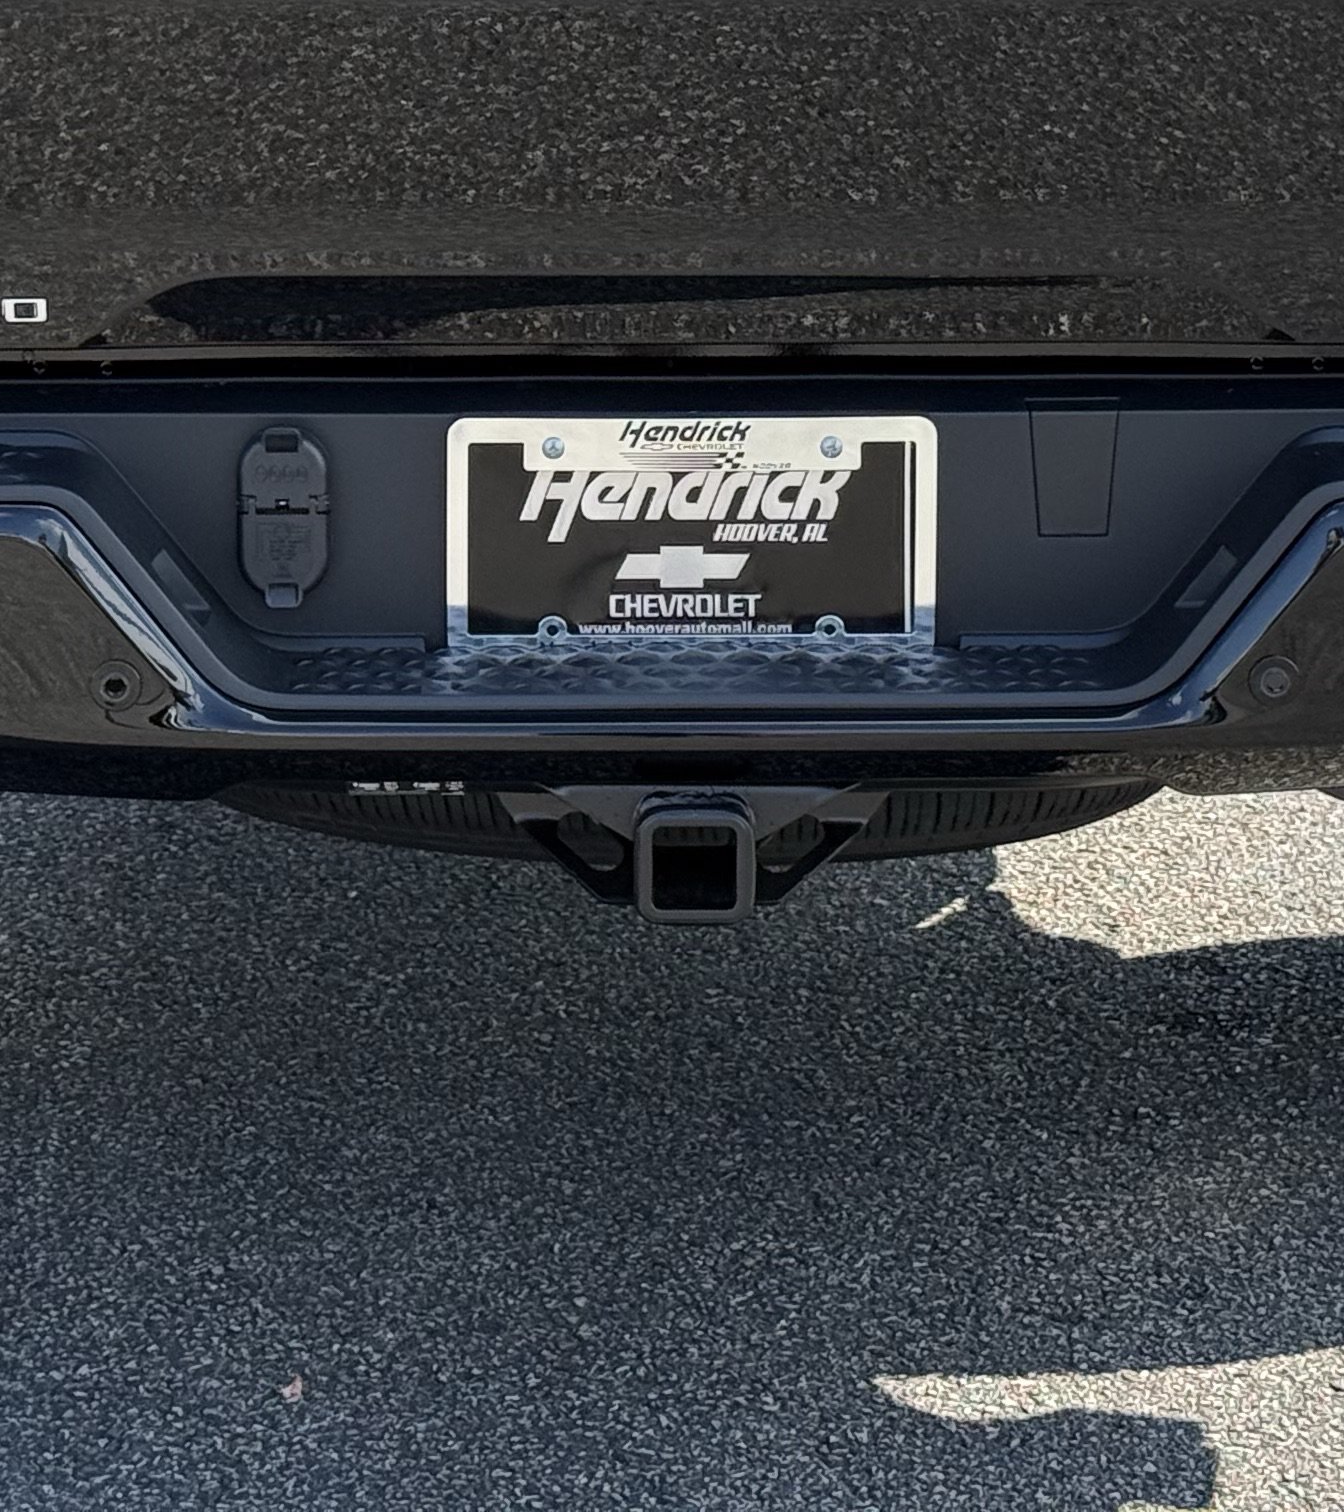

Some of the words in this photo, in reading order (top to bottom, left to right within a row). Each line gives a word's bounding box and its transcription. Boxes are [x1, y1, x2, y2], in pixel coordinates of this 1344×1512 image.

[619, 420, 752, 449] Hendrick
[676, 442, 744, 451] CHEVROLET
[519, 470, 853, 544] Hendrick
[712, 522, 799, 544] HOOVER,
[802, 522, 829, 543] AL
[609, 593, 762, 619] CHEVROLET
[578, 620, 793, 635] www.hooverautomall.com
